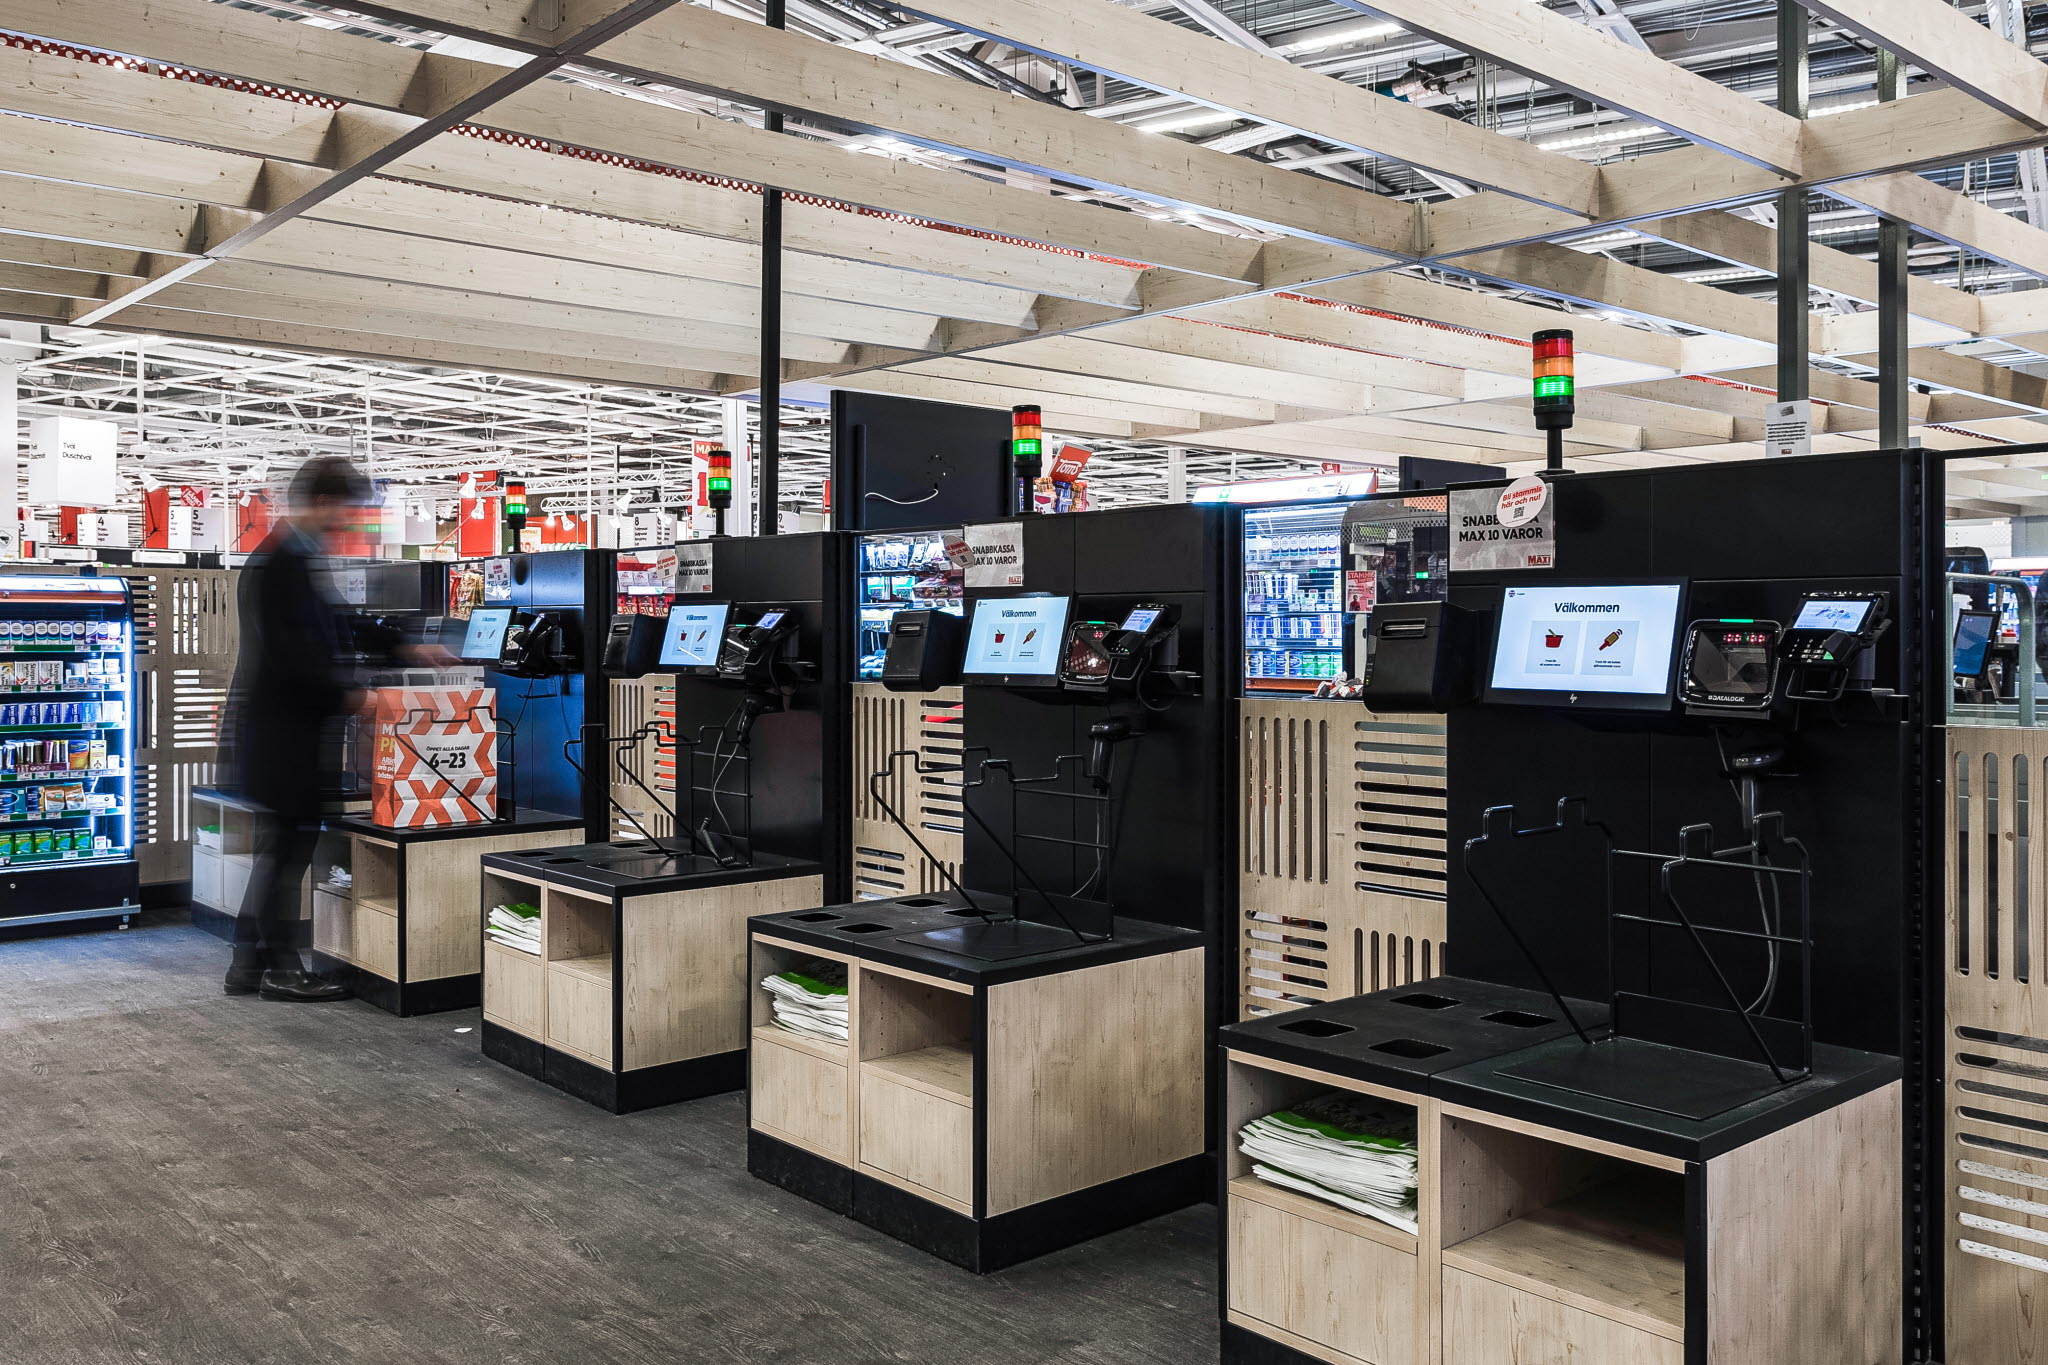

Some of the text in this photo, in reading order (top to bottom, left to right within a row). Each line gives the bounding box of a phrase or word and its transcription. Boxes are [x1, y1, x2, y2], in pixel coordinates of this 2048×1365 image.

[1056, 459, 1083, 475] Toms
[1503, 486, 1542, 501] Bli stammis
[1501, 493, 1541, 509] här och nu!
[193, 510, 199, 519] 5
[1462, 513, 1540, 527] SNABBA
[98, 517, 104, 526] 4
[635, 517, 640, 526] 8
[20, 523, 25, 532] 3
[1459, 527, 1543, 542] MAX 10 VAROR
[972, 544, 1015, 555] SNABBKASSA
[986, 557, 993, 565] 10
[994, 556, 1018, 565] VAROR
[1528, 555, 1551, 567] MAXI
[694, 568, 709, 576] VAROR
[1554, 602, 1620, 613] Välkommen
[1002, 609, 1036, 618] Välkommen
